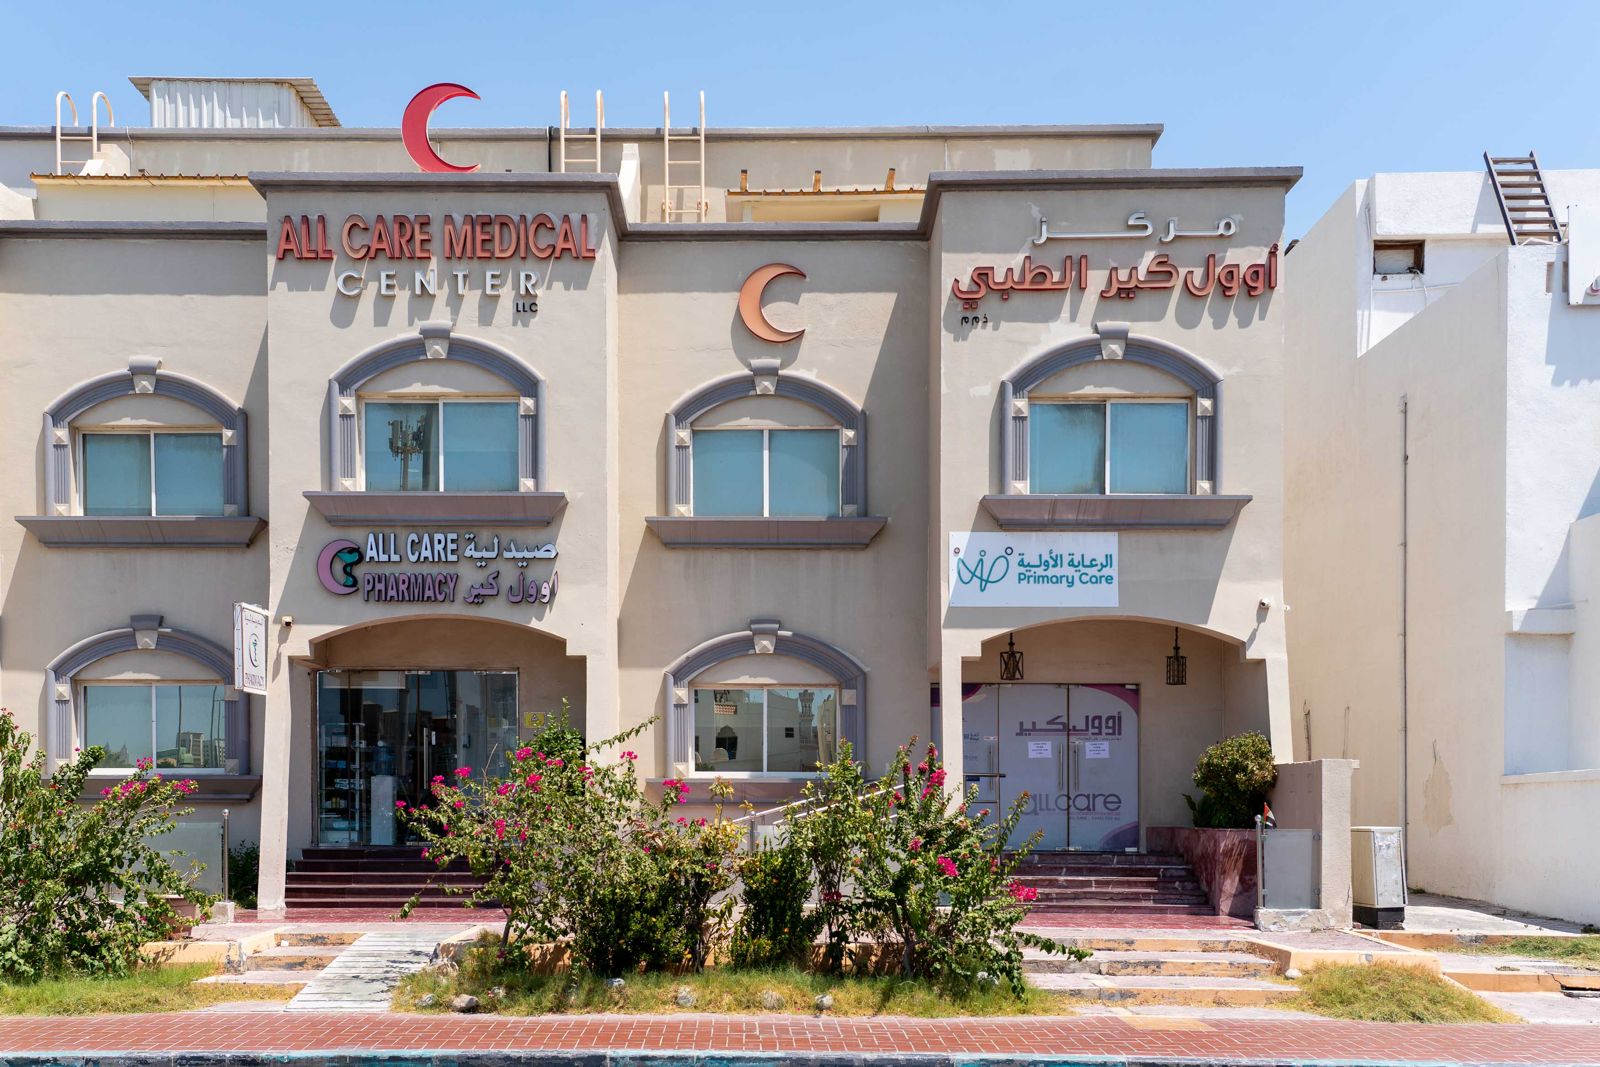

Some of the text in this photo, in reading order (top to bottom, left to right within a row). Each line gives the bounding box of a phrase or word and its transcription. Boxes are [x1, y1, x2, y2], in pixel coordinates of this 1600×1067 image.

[276, 213, 596, 260] ALL CARE MEDICAL
[1032, 210, 1237, 245] مركز
[336, 269, 539, 297] CENTER
[952, 255, 1088, 309] الطبي
[515, 302, 539, 313] LLC
[365, 532, 459, 564] ALL CARE
[463, 533, 559, 567] صيدلية
[1068, 553, 1113, 572] الرعاية
[363, 572, 459, 603] PHARMACY
[464, 571, 500, 605] كير
[1018, 572, 1114, 588] Primary Care
